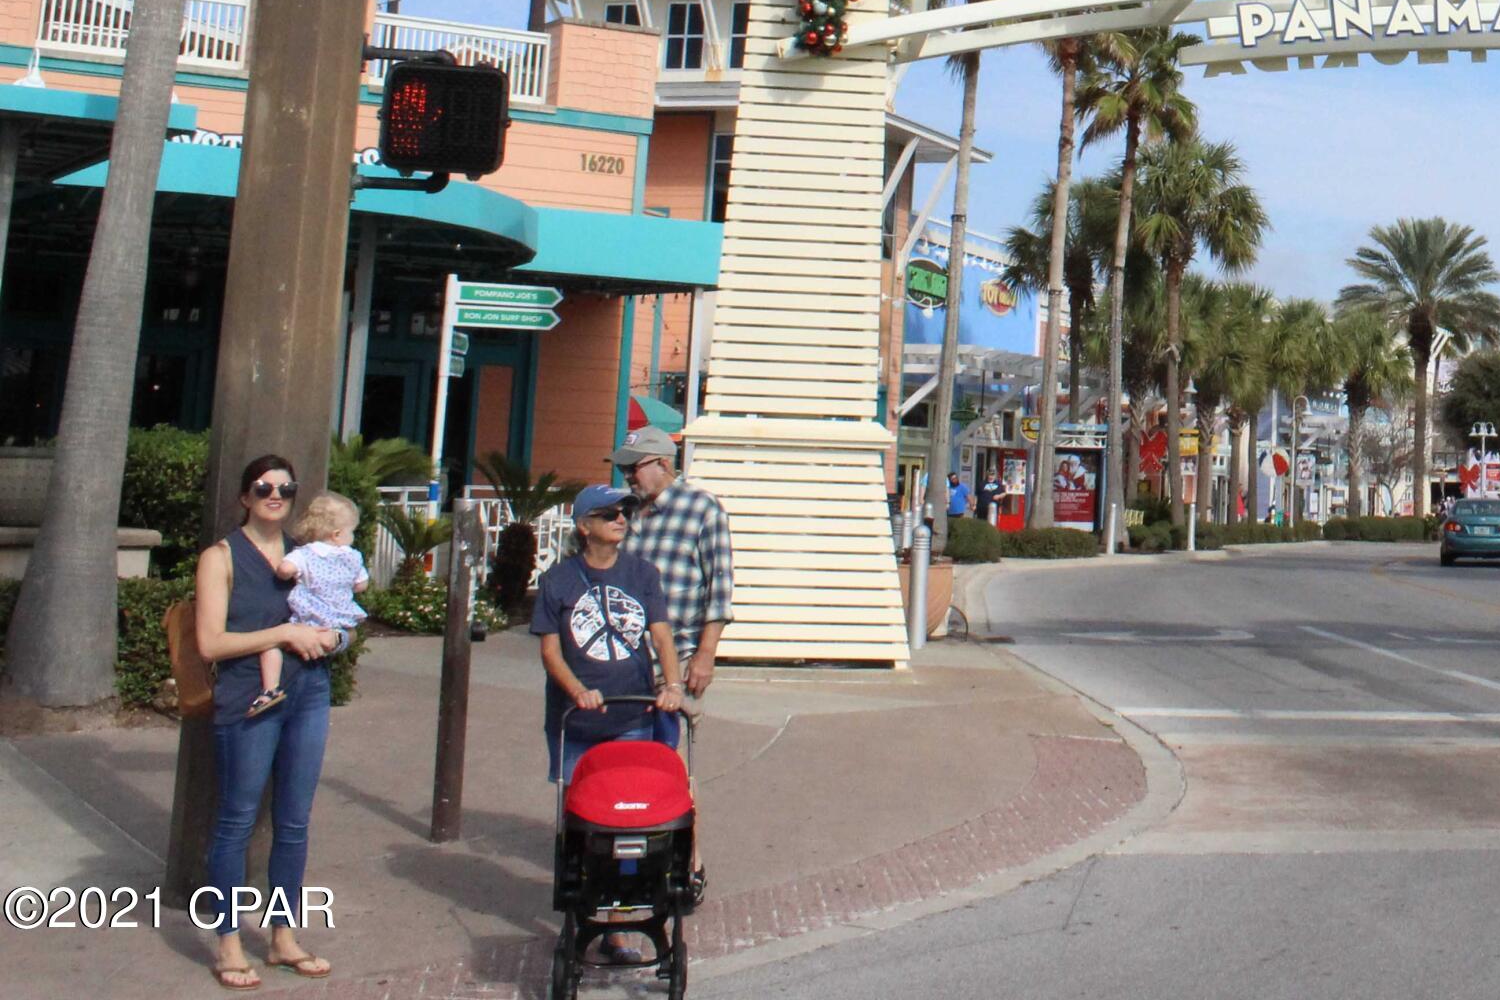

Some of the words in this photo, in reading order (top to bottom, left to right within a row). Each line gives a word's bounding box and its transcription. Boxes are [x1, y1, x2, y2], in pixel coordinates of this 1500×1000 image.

[581, 153, 625, 175] 16220
[474, 289, 515, 299] POMPANO
[482, 312, 499, 321] JON
[501, 313, 520, 321] SURF
[521, 314, 542, 323] SHOP
